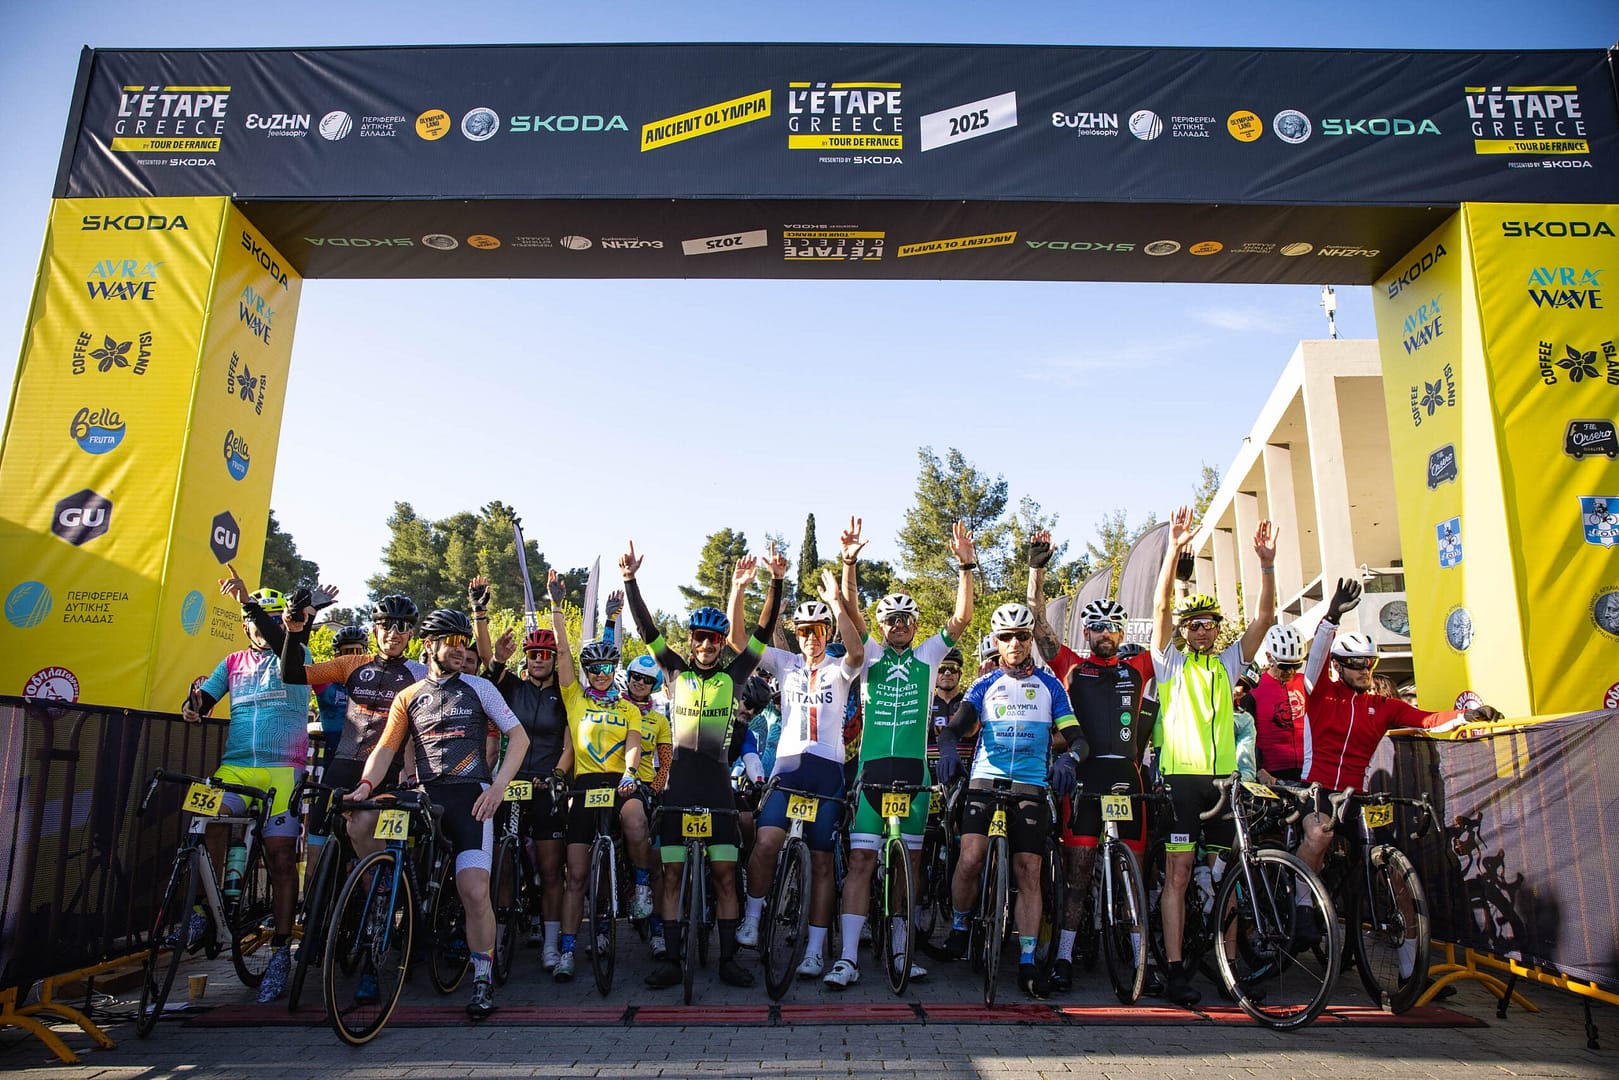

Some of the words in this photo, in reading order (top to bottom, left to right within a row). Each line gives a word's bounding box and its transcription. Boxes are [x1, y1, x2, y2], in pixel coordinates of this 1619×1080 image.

[362, 115, 406, 123] ΠΕΡΙΦΕΡΕΙΑ
[419, 114, 445, 125] OLYMPIAN
[426, 120, 440, 129] LAND
[645, 115, 702, 145] ANCIENT
[703, 97, 767, 127] OLYMPIA
[788, 116, 903, 131] GREECE
[949, 109, 990, 136] 2025
[1230, 115, 1255, 126] OLYMPIAN
[1238, 122, 1252, 130] LAND
[115, 120, 225, 135] GREECE
[1471, 121, 1587, 137] GREECE
[150, 140, 171, 149] TOUR
[173, 140, 184, 149] DE
[185, 140, 217, 149] FRANCE
[829, 137, 851, 147] TOUR
[853, 137, 864, 147] DE
[866, 137, 899, 147] FRANCE
[1514, 142, 1537, 151] TOUR
[1540, 142, 1550, 151] DE
[1552, 142, 1585, 151] FRANCE
[706, 236, 743, 249] 2025
[783, 239, 884, 247] GREECE
[902, 240, 959, 254] OLYMPIA
[960, 234, 1012, 247] ANCIENT
[87, 259, 164, 278] AVRA
[1527, 267, 1604, 286] AVRA
[87, 281, 156, 300] WAVE
[240, 285, 275, 325] AVRA
[1528, 289, 1603, 309] WAVE
[1402, 294, 1442, 337] AVRA
[239, 301, 272, 346] WAVE
[1403, 315, 1444, 356] WAVE
[72, 331, 92, 375] COFFEE
[133, 331, 152, 376] ISLAND
[1540, 340, 1558, 386] COFFEE
[1600, 340, 1619, 386] ISLAND
[227, 351, 240, 395] COFFEE
[1442, 363, 1456, 408] ISLAND
[255, 374, 267, 416] ISLAND
[1411, 385, 1422, 427] COFFEE
[70, 407, 124, 441] Bella
[89, 436, 116, 444] FRUTTA
[223, 429, 250, 460] Bella
[1573, 430, 1612, 445] Orsero
[231, 460, 245, 473] FRUTTA
[59, 508, 105, 527] GU
[214, 526, 236, 550] GU
[67, 591, 129, 601] ΠΕΡΙΦΕΡΕΙΑ
[65, 603, 111, 612] ΔΥΤΙΚΗΣ
[63, 614, 114, 624] ΕΛΛΑΔΑΣ
[786, 690, 833, 705] TITANS
[876, 699, 919, 707] FOCUS
[1006, 703, 1038, 711] ΟΛΥΜΠΙΑ
[508, 786, 528, 797] 303
[589, 793, 610, 803] 350
[190, 792, 216, 810] 536
[791, 800, 814, 816] 601
[885, 802, 907, 813] 704
[1105, 804, 1128, 816] 420
[382, 819, 403, 834] 716
[686, 823, 708, 833] 616
